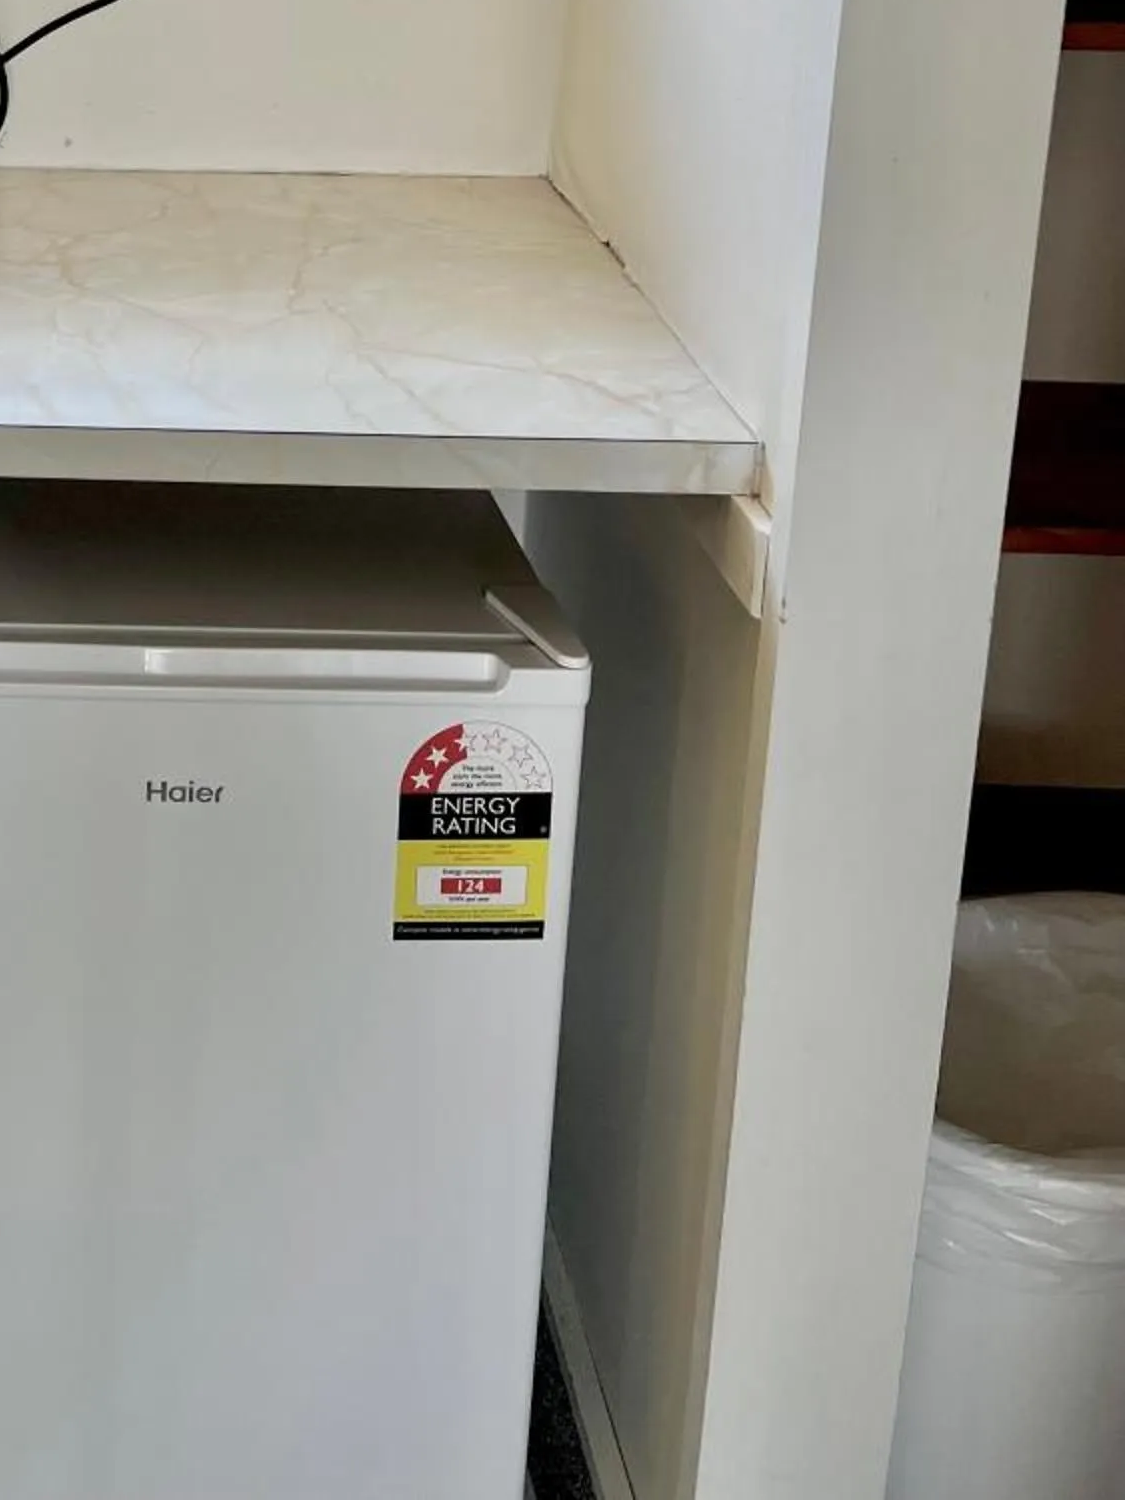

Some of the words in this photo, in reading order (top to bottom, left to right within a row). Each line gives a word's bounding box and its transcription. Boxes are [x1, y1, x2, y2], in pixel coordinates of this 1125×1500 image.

[146, 780, 224, 803] Haier
[431, 797, 521, 815] ENERGY
[432, 816, 516, 835] RATING
[457, 879, 484, 893] 124
